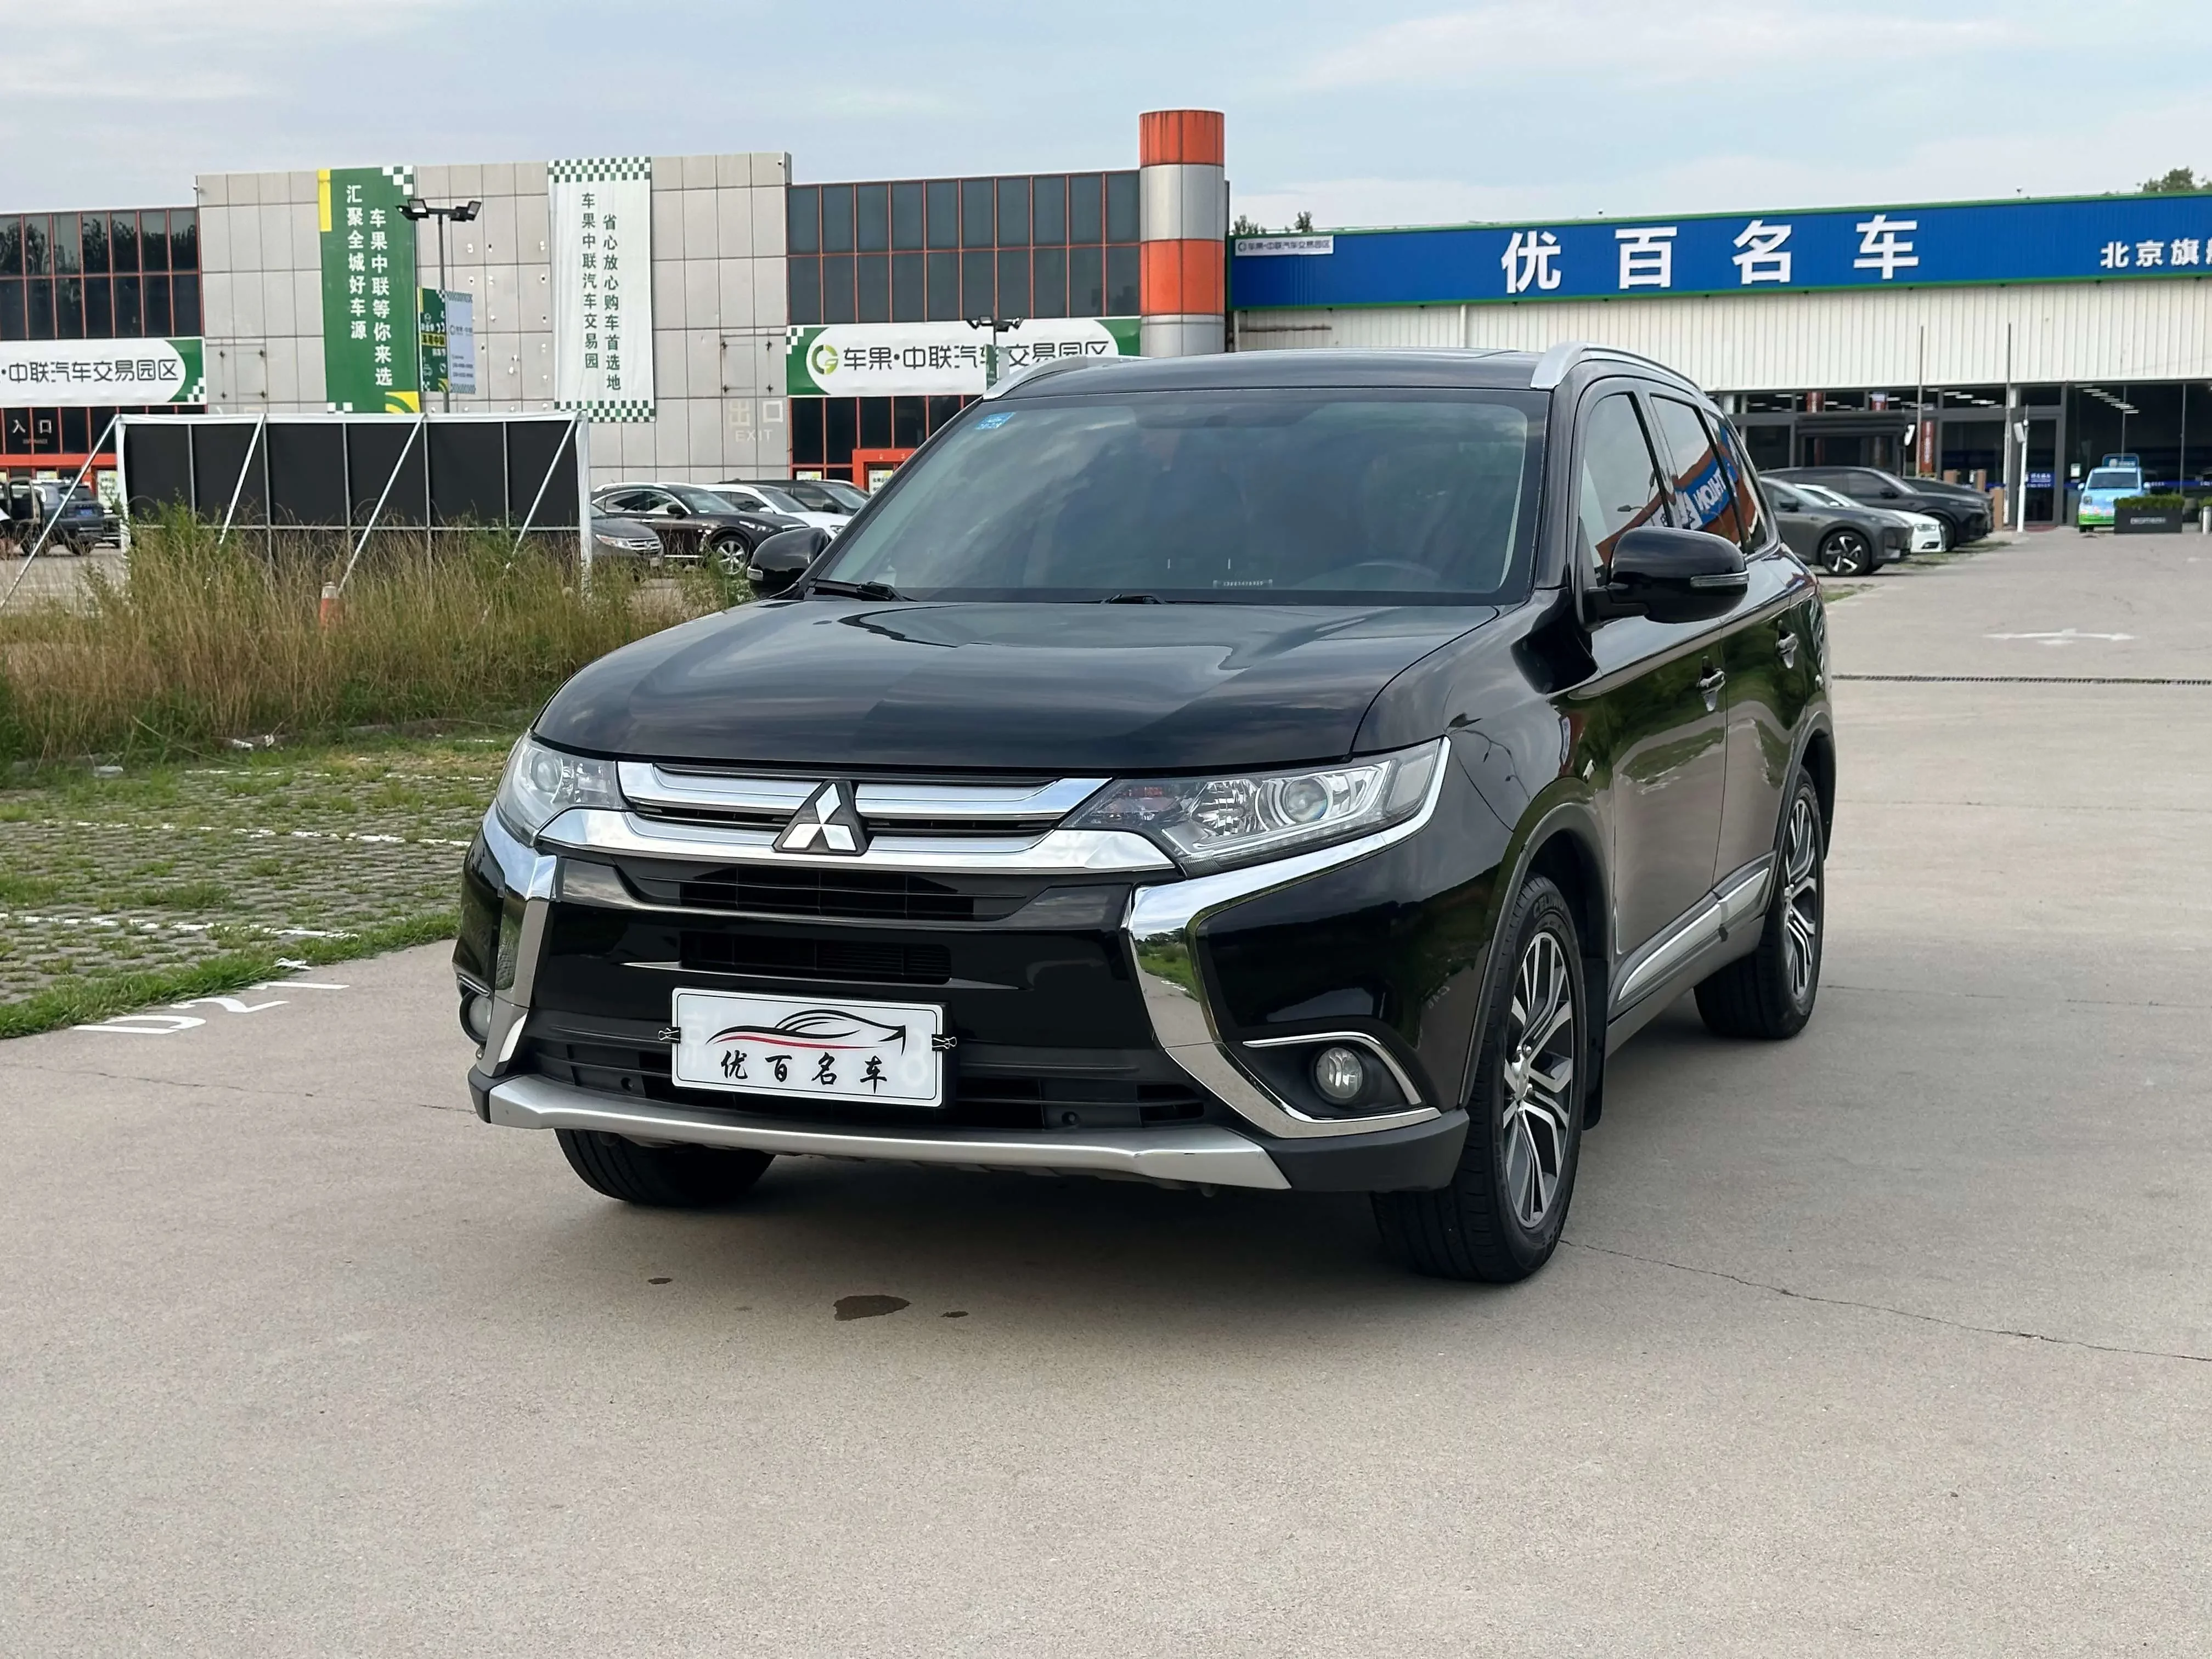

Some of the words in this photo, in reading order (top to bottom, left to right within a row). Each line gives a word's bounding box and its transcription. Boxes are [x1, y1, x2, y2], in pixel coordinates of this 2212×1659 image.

[346, 184, 367, 340] 汇聚全城好车源
[582, 193, 599, 369] 车果中联汽车交易园
[1500, 215, 1919, 294] 优百名车
[2100, 238, 2212, 269] 北京旗
[370, 208, 393, 386] 车果中联等你来选
[603, 212, 622, 391] 省心放心购车首选地
[12, 419, 52, 433] 入口
[735, 429, 773, 442] EXIT
[720, 1049, 887, 1093] 优百名车
